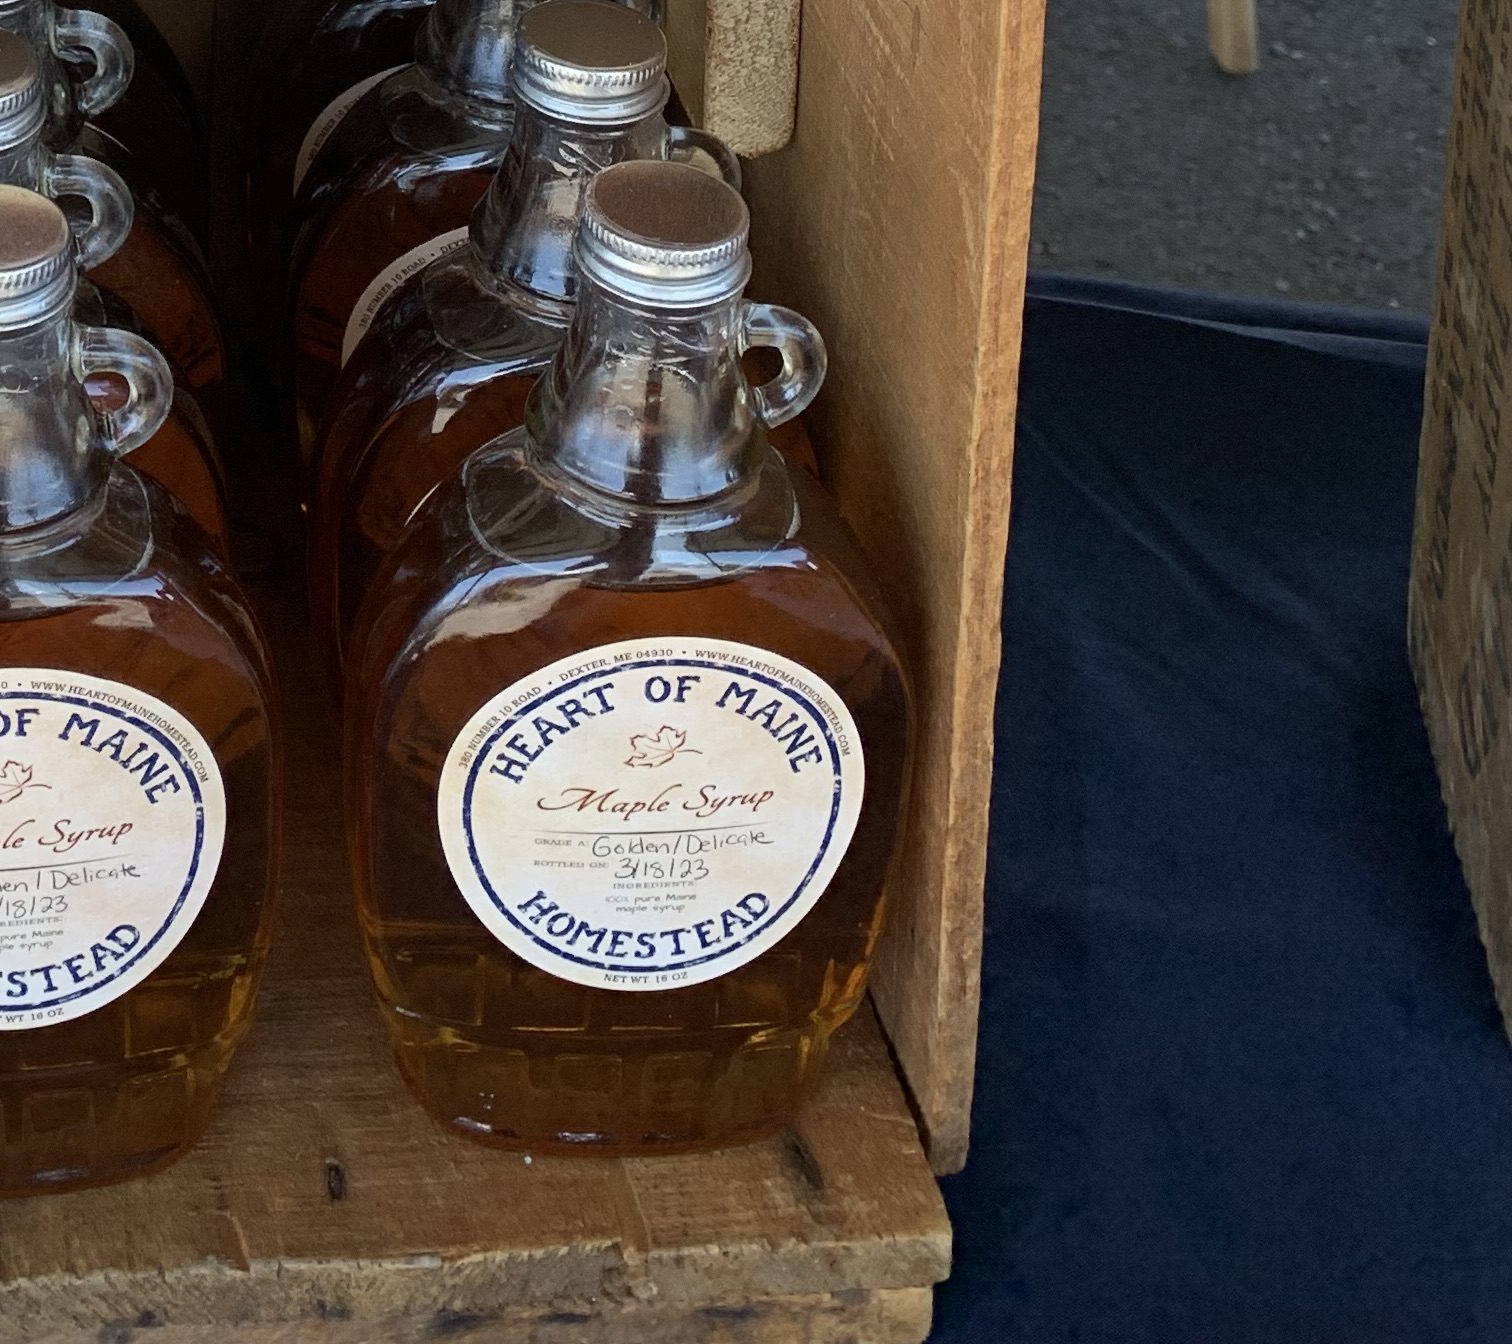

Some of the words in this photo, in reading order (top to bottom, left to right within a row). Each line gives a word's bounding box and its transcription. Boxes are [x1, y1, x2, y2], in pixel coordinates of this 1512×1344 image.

[614, 653, 632, 663] ME
[489, 683, 615, 785] HEART
[645, 676, 701, 703] OF
[715, 681, 823, 774] MAINE
[58, 713, 181, 805] MAINE
[538, 784, 681, 821] Maple
[683, 785, 774, 818] Syrup
[38, 820, 133, 853] Syrup
[516, 890, 770, 959] HOMESTEAD
